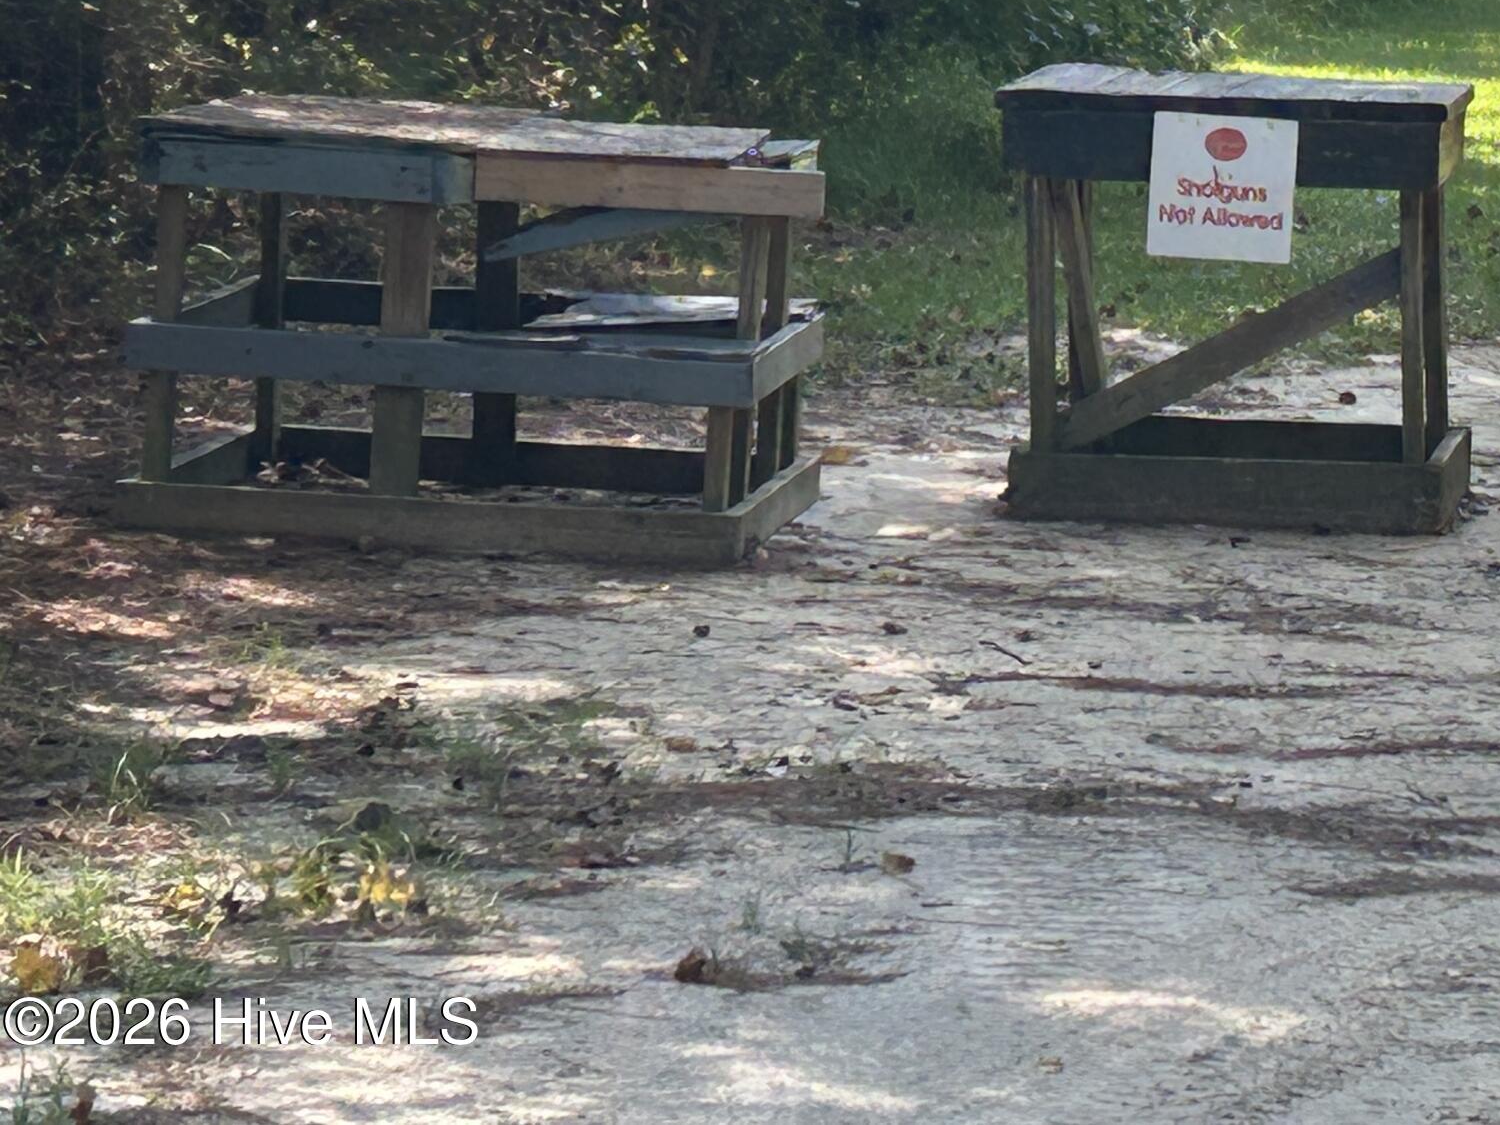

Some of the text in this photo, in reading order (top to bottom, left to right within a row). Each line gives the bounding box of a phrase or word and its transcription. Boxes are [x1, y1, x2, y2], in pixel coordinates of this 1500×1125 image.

[1176, 170, 1267, 203] Shotguns
[1159, 203, 1284, 230] Not Allowed
